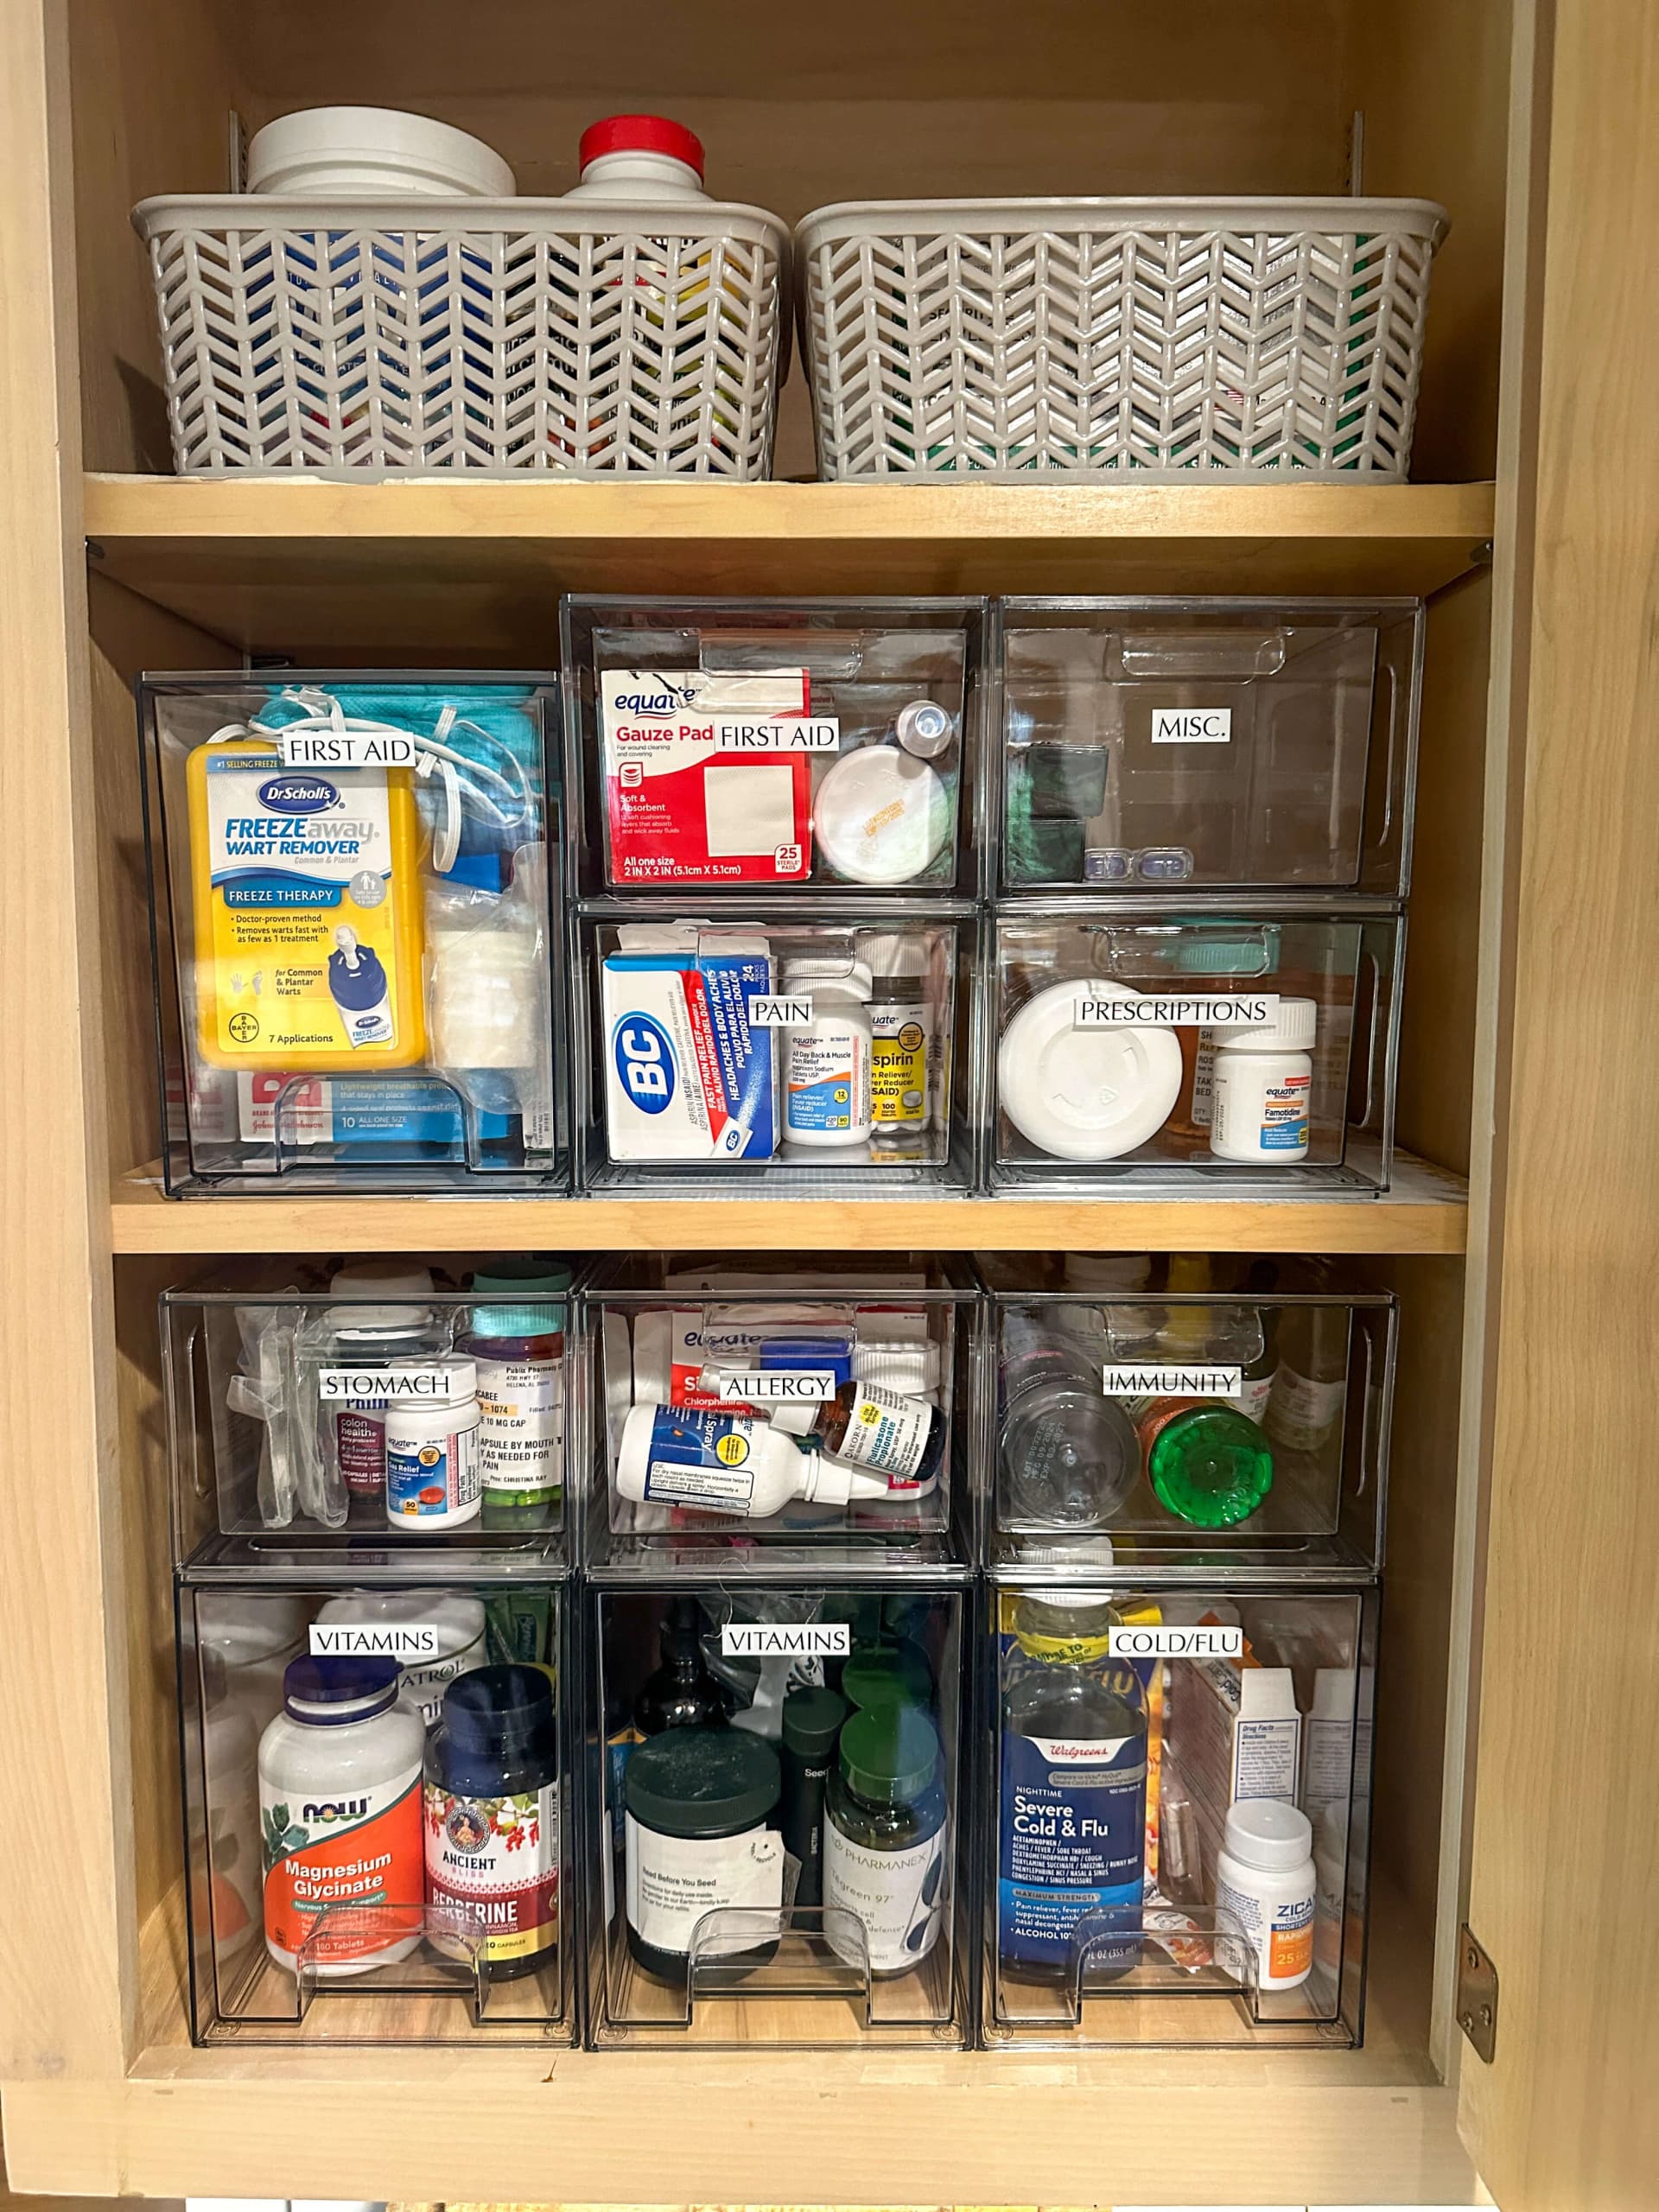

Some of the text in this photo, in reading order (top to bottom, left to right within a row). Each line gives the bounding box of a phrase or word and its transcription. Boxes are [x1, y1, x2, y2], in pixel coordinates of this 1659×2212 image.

[616, 726, 673, 741] Gauze
[1159, 716, 1226, 739] MISC.
[721, 726, 835, 747] FIRST AID
[290, 740, 410, 761] FIRST AID
[255, 760, 278, 768] FREEZE
[620, 794, 646, 803] Soft &
[620, 804, 666, 812] Absorbent
[226, 817, 309, 838] FREEZE
[226, 840, 359, 855] WART REMOVER
[779, 848, 798, 859] 25
[295, 856, 359, 865] Common Plantar
[624, 857, 637, 866] All
[657, 856, 675, 866] size
[624, 864, 741, 876] 2 IN X 2 IN (5.1cm X 5.1cm)
[229, 890, 333, 901] FREEZE THERAPY
[236, 914, 321, 924] Doctor-proven method
[237, 926, 271, 935] Removes
[295, 925, 310, 934] fast
[311, 925, 329, 934] with
[276, 969, 286, 978] for
[735, 1001, 747, 1020] DEL
[756, 1002, 809, 1021] PAIN
[1081, 1001, 1267, 1021] PRESCRIPTIONS
[276, 1034, 334, 1045] Applications
[707, 969, 741, 1101] HEADACHES BODY ACHES
[727, 1013, 746, 1069] POLVO PARA
[792, 1036, 818, 1046] equate
[621, 1029, 668, 1096] BC
[694, 1029, 716, 1109] FAST PAIN RELIEF
[878, 1071, 912, 1079] Reliever/
[385, 1091, 405, 1100] place
[1266, 1086, 1296, 1096] equate
[341, 1117, 356, 1128] 10
[727, 1132, 739, 1149] BC
[506, 1366, 526, 1375] Publix
[326, 1375, 449, 1395] STOMACH
[726, 1376, 831, 1396] ALLERGY
[1109, 1372, 1237, 1392] IMMUNITY
[340, 1417, 368, 1427] colon
[496, 1419, 508, 1427] MG
[511, 1419, 526, 1427] CAP
[341, 1427, 372, 1438] health
[511, 1438, 554, 1450] BY MOUTH
[867, 1415, 889, 1464] Fluticasone
[874, 1421, 896, 1466] Propionate
[486, 1449, 550, 1461] AS NEEDED FOR
[398, 1464, 420, 1473] Relief
[482, 1459, 499, 1471] PAIN
[316, 1631, 434, 1651] VITAMINS
[728, 1630, 847, 1652] VITAMINS
[1116, 1632, 1239, 1653] COLD/FLU
[1257, 1724, 1274, 1732] Facts
[1050, 1745, 1109, 1759] Walgreens
[1015, 1785, 1063, 1798] NIGHTTIME
[1014, 1795, 1073, 1818] Severe
[1014, 1815, 1109, 1837] Cold & Flu
[1012, 1834, 1058, 1847] ACETAMINOPHEN
[1012, 1842, 1029, 1852] ACHES
[442, 1850, 497, 1871] ANCIENT
[845, 1851, 927, 1872] PHARMANEX
[1012, 1849, 1069, 1863] DEXTROMETHORPHAN
[284, 1852, 392, 1881] Magnesium
[1012, 1856, 1046, 1868] DOXYLAMINE
[1046, 1861, 1074, 1870] SUCCINATE
[1012, 1864, 1055, 1876] PHENYLEPHRINE
[1093, 1868, 1109, 1877] SINUS
[658, 1873, 716, 1887] Before You Seed
[1012, 1871, 1045, 1883] CONGESTION
[1050, 1876, 1066, 1885] SINUS
[294, 1873, 385, 1901] Glycinate
[1015, 1890, 1054, 1900] MAXIMUM
[295, 1901, 323, 1911] Nervous
[1015, 1900, 1080, 1914] Pain reliever, fever
[1014, 1910, 1060, 1923] suppressant,
[1014, 1918, 1033, 1927] nasal
[1014, 1927, 1059, 1940] ALCOHOL
[334, 1939, 365, 1951] Tablets
[1276, 1952, 1294, 1965] 25
